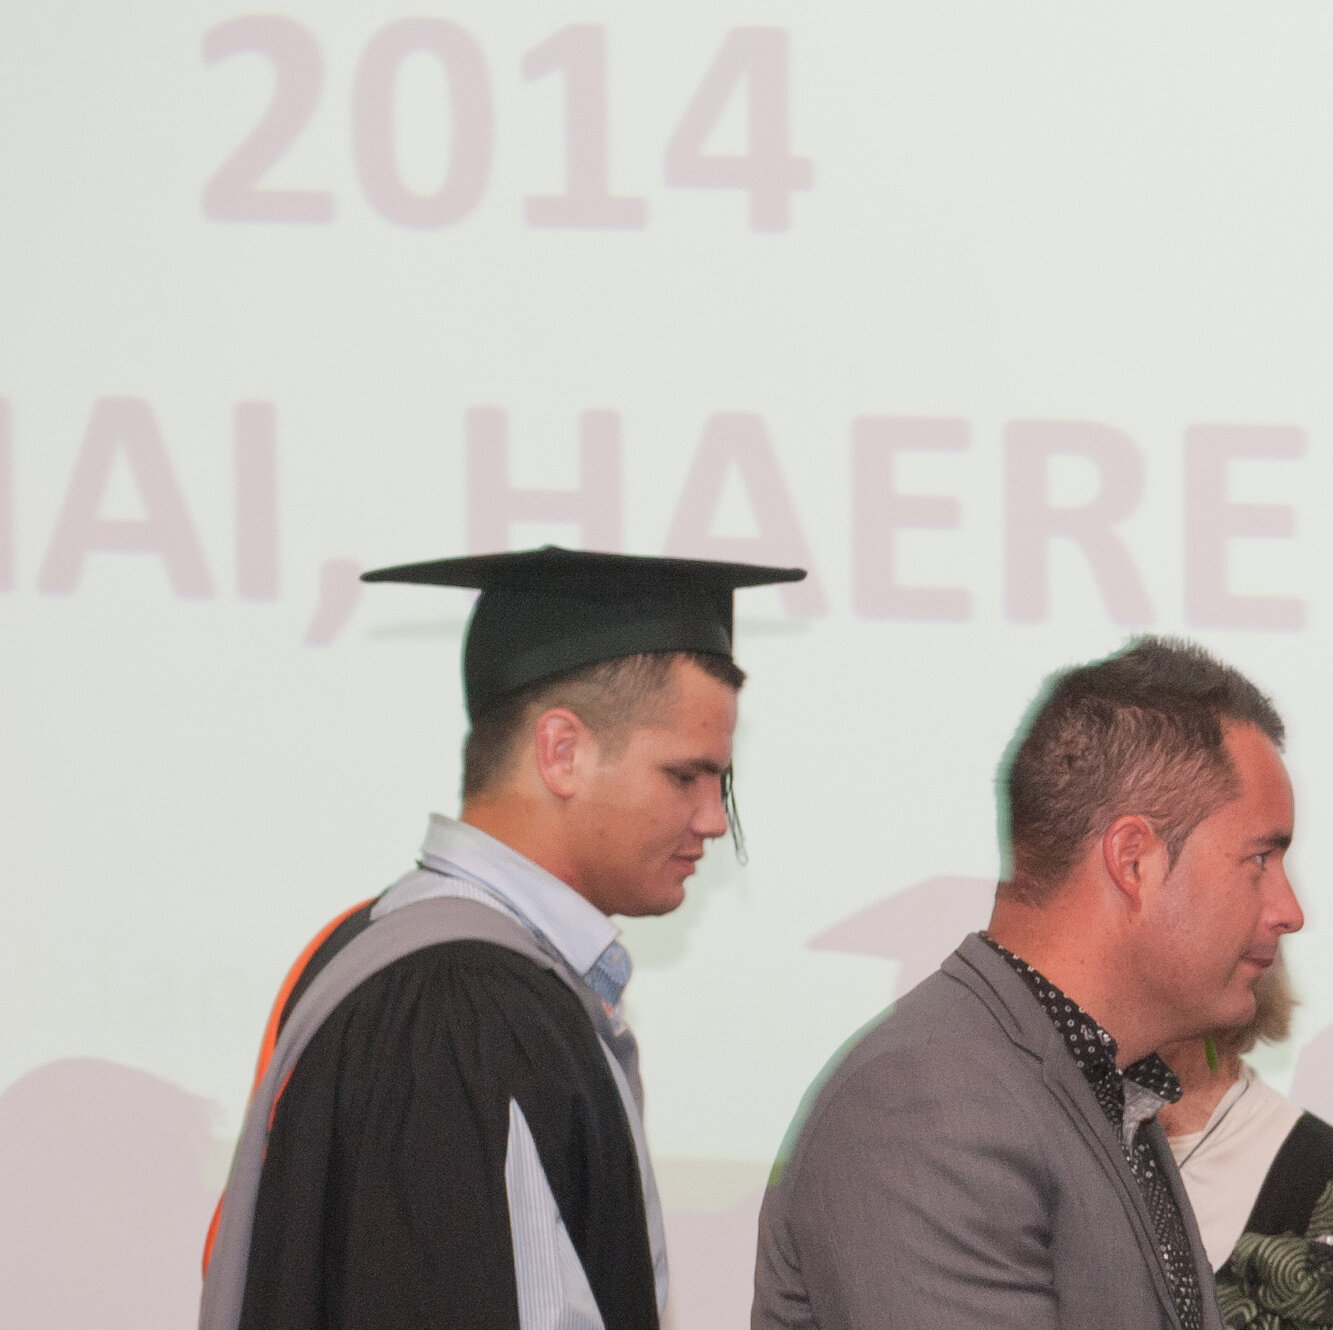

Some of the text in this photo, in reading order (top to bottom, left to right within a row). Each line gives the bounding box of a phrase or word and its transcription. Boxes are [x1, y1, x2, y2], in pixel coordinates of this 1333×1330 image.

[200, 12, 816, 234] 2014
[0, 393, 367, 647] AI,
[464, 403, 1309, 633] HAERE
